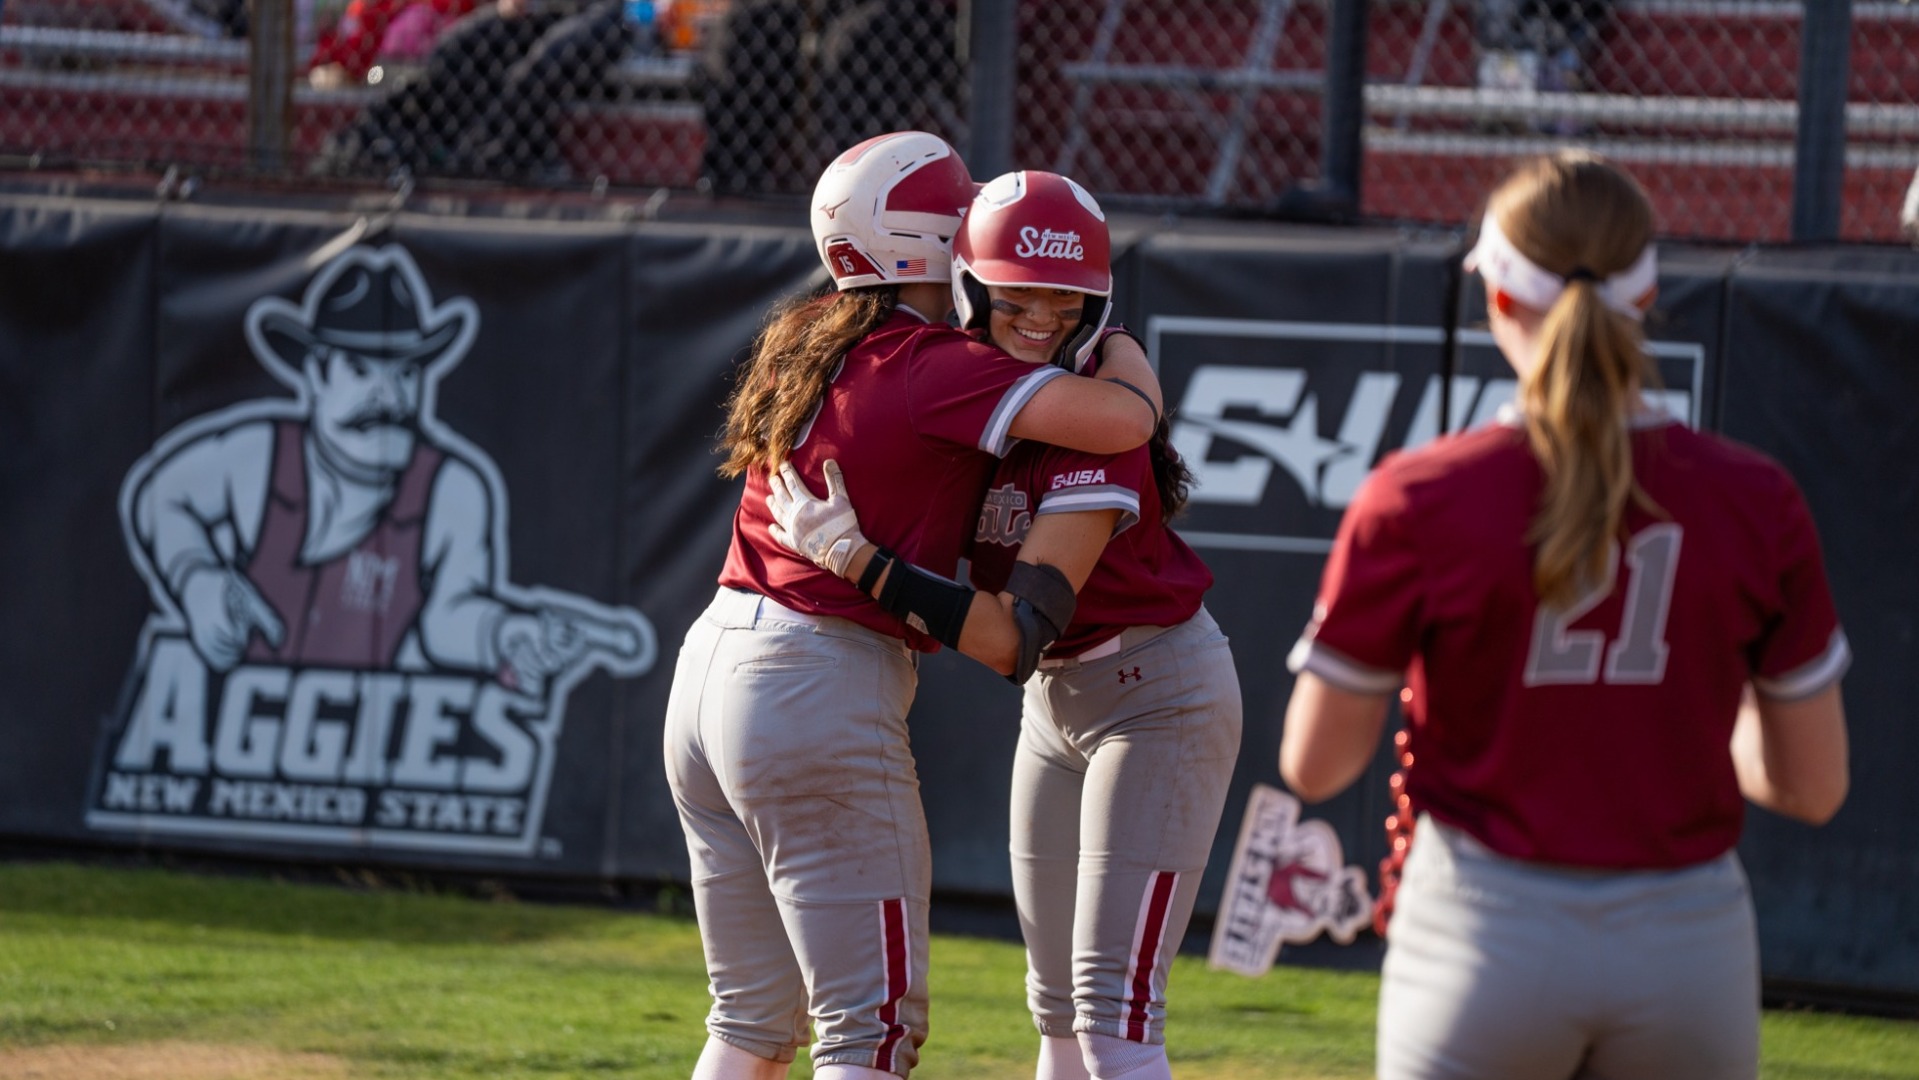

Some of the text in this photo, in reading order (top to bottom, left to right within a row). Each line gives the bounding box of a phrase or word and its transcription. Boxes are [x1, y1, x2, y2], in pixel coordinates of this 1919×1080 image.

[838, 255, 855, 273] 15
[1015, 226, 1084, 261] State
[974, 482, 1031, 547] ate
[1522, 522, 1684, 687] 21
[114, 637, 540, 793] AGGIES
[105, 772, 524, 833] NEW MEXICO STATE
